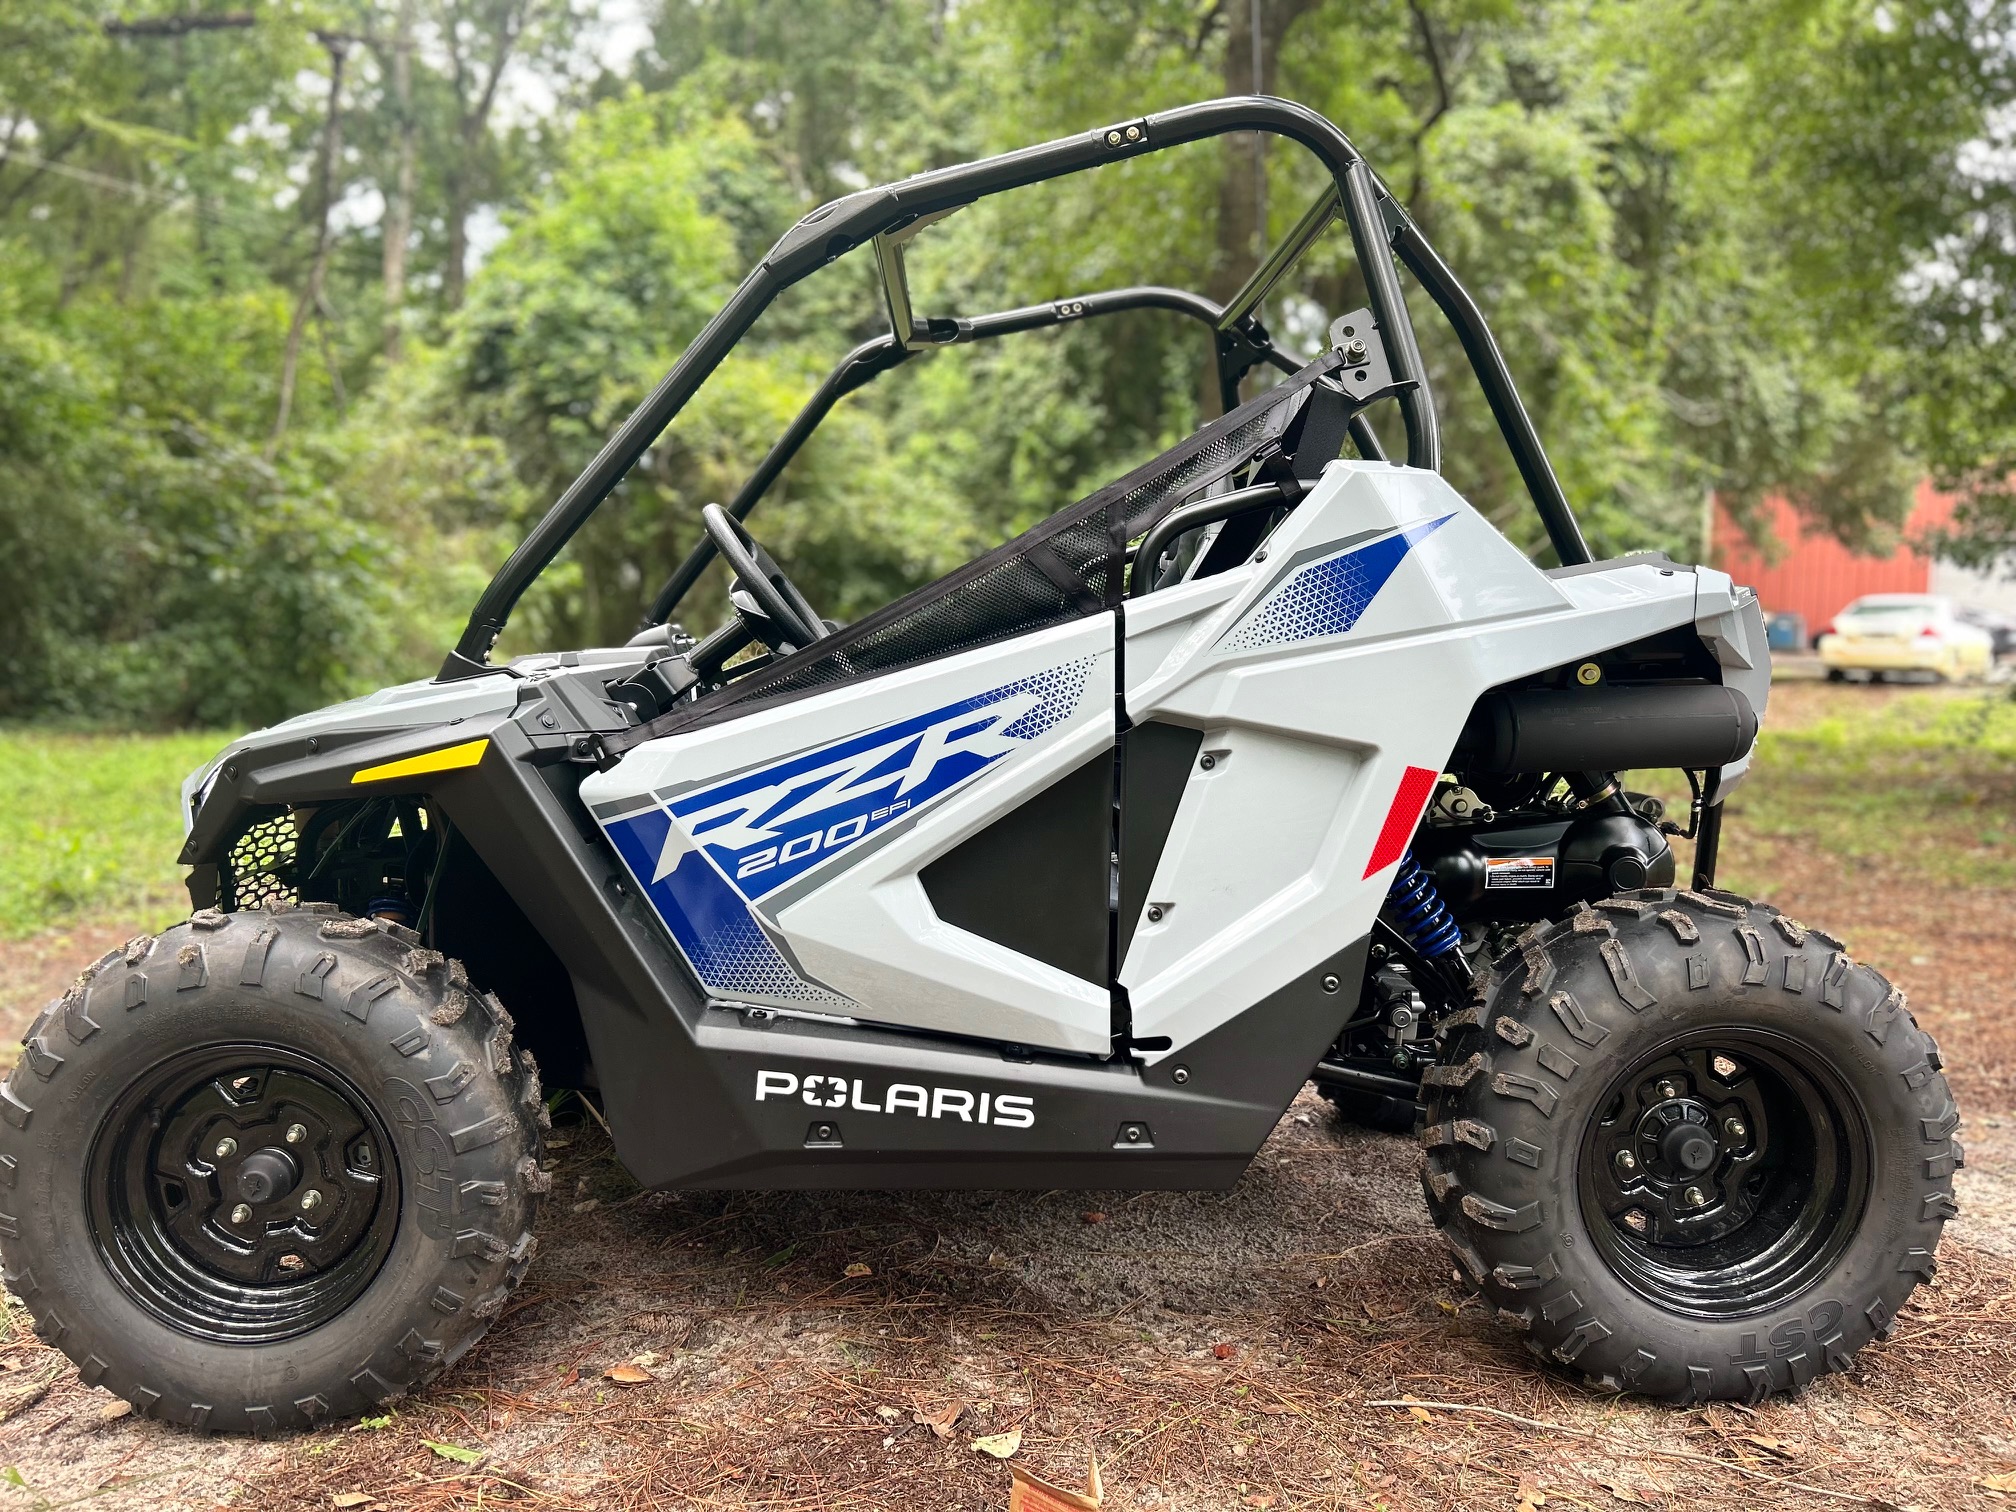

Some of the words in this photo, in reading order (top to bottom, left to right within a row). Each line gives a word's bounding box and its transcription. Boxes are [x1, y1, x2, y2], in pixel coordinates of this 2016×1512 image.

[652, 692, 1044, 885] RZR
[736, 813, 869, 880] 200
[870, 798, 911, 822] EFI
[67, 1070, 97, 1102] NYLON
[755, 1069, 1035, 1129] POLARIS
[383, 1077, 453, 1230] CST
[1729, 1299, 1844, 1365] CST
